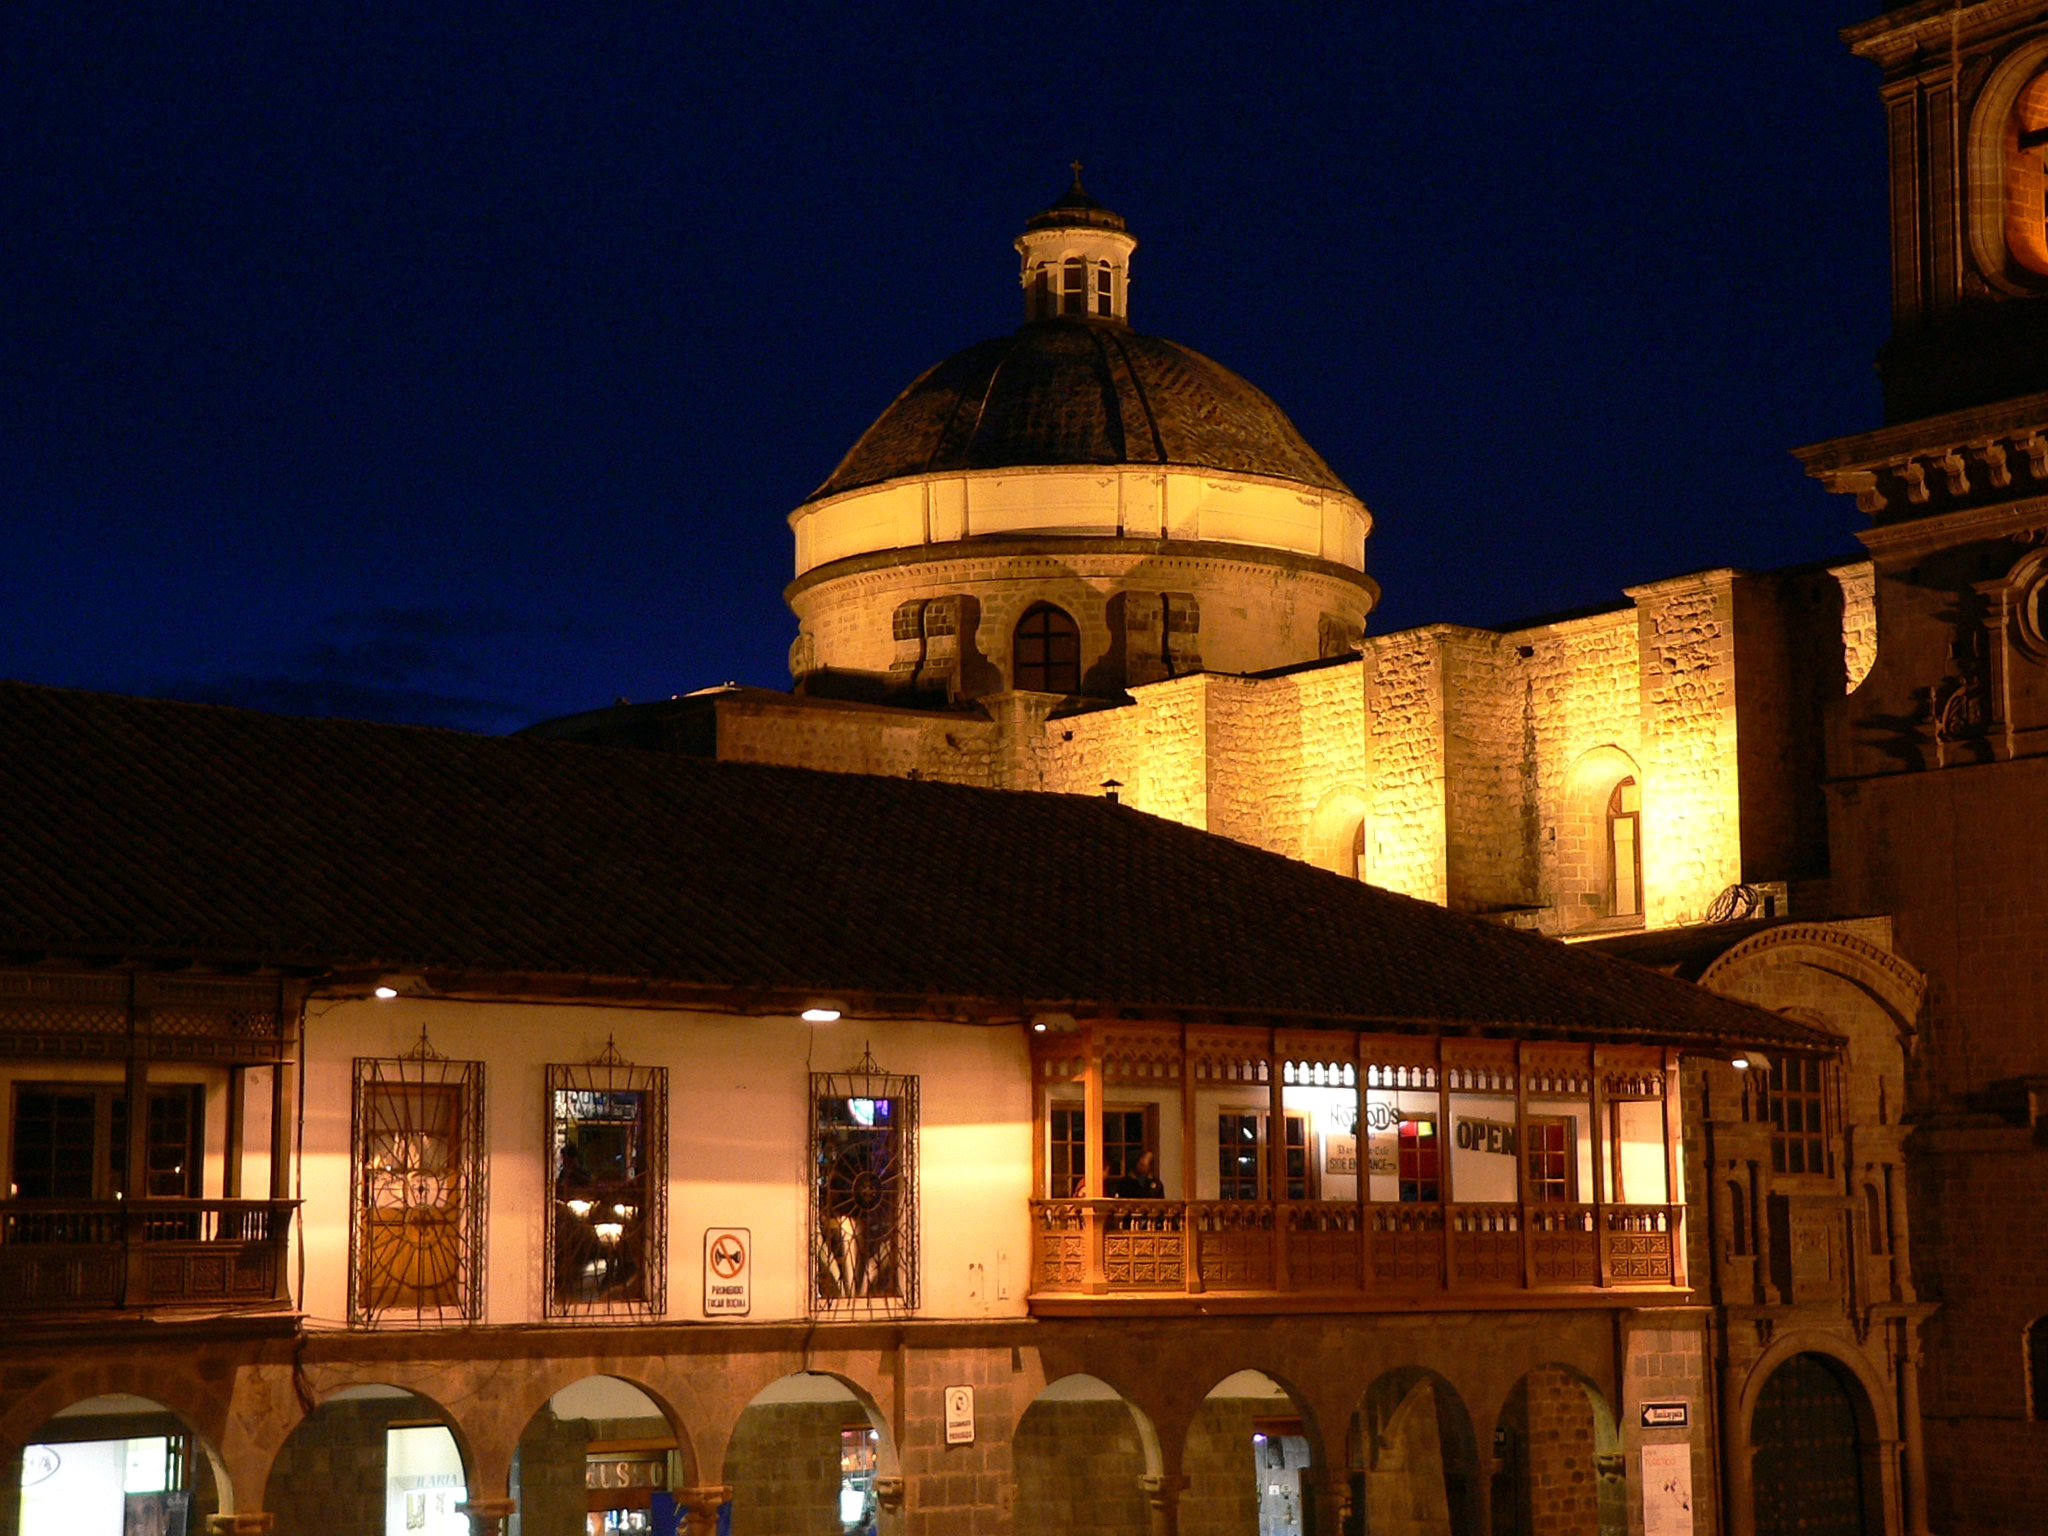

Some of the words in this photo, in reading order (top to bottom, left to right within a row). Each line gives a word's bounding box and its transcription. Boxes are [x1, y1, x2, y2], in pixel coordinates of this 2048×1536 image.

[1330, 1101, 1400, 1130] Noron's
[1457, 1121, 1518, 1156] OPEN
[1330, 1158, 1347, 1170] SIDE
[711, 1285, 744, 1295] PROHIBIDO
